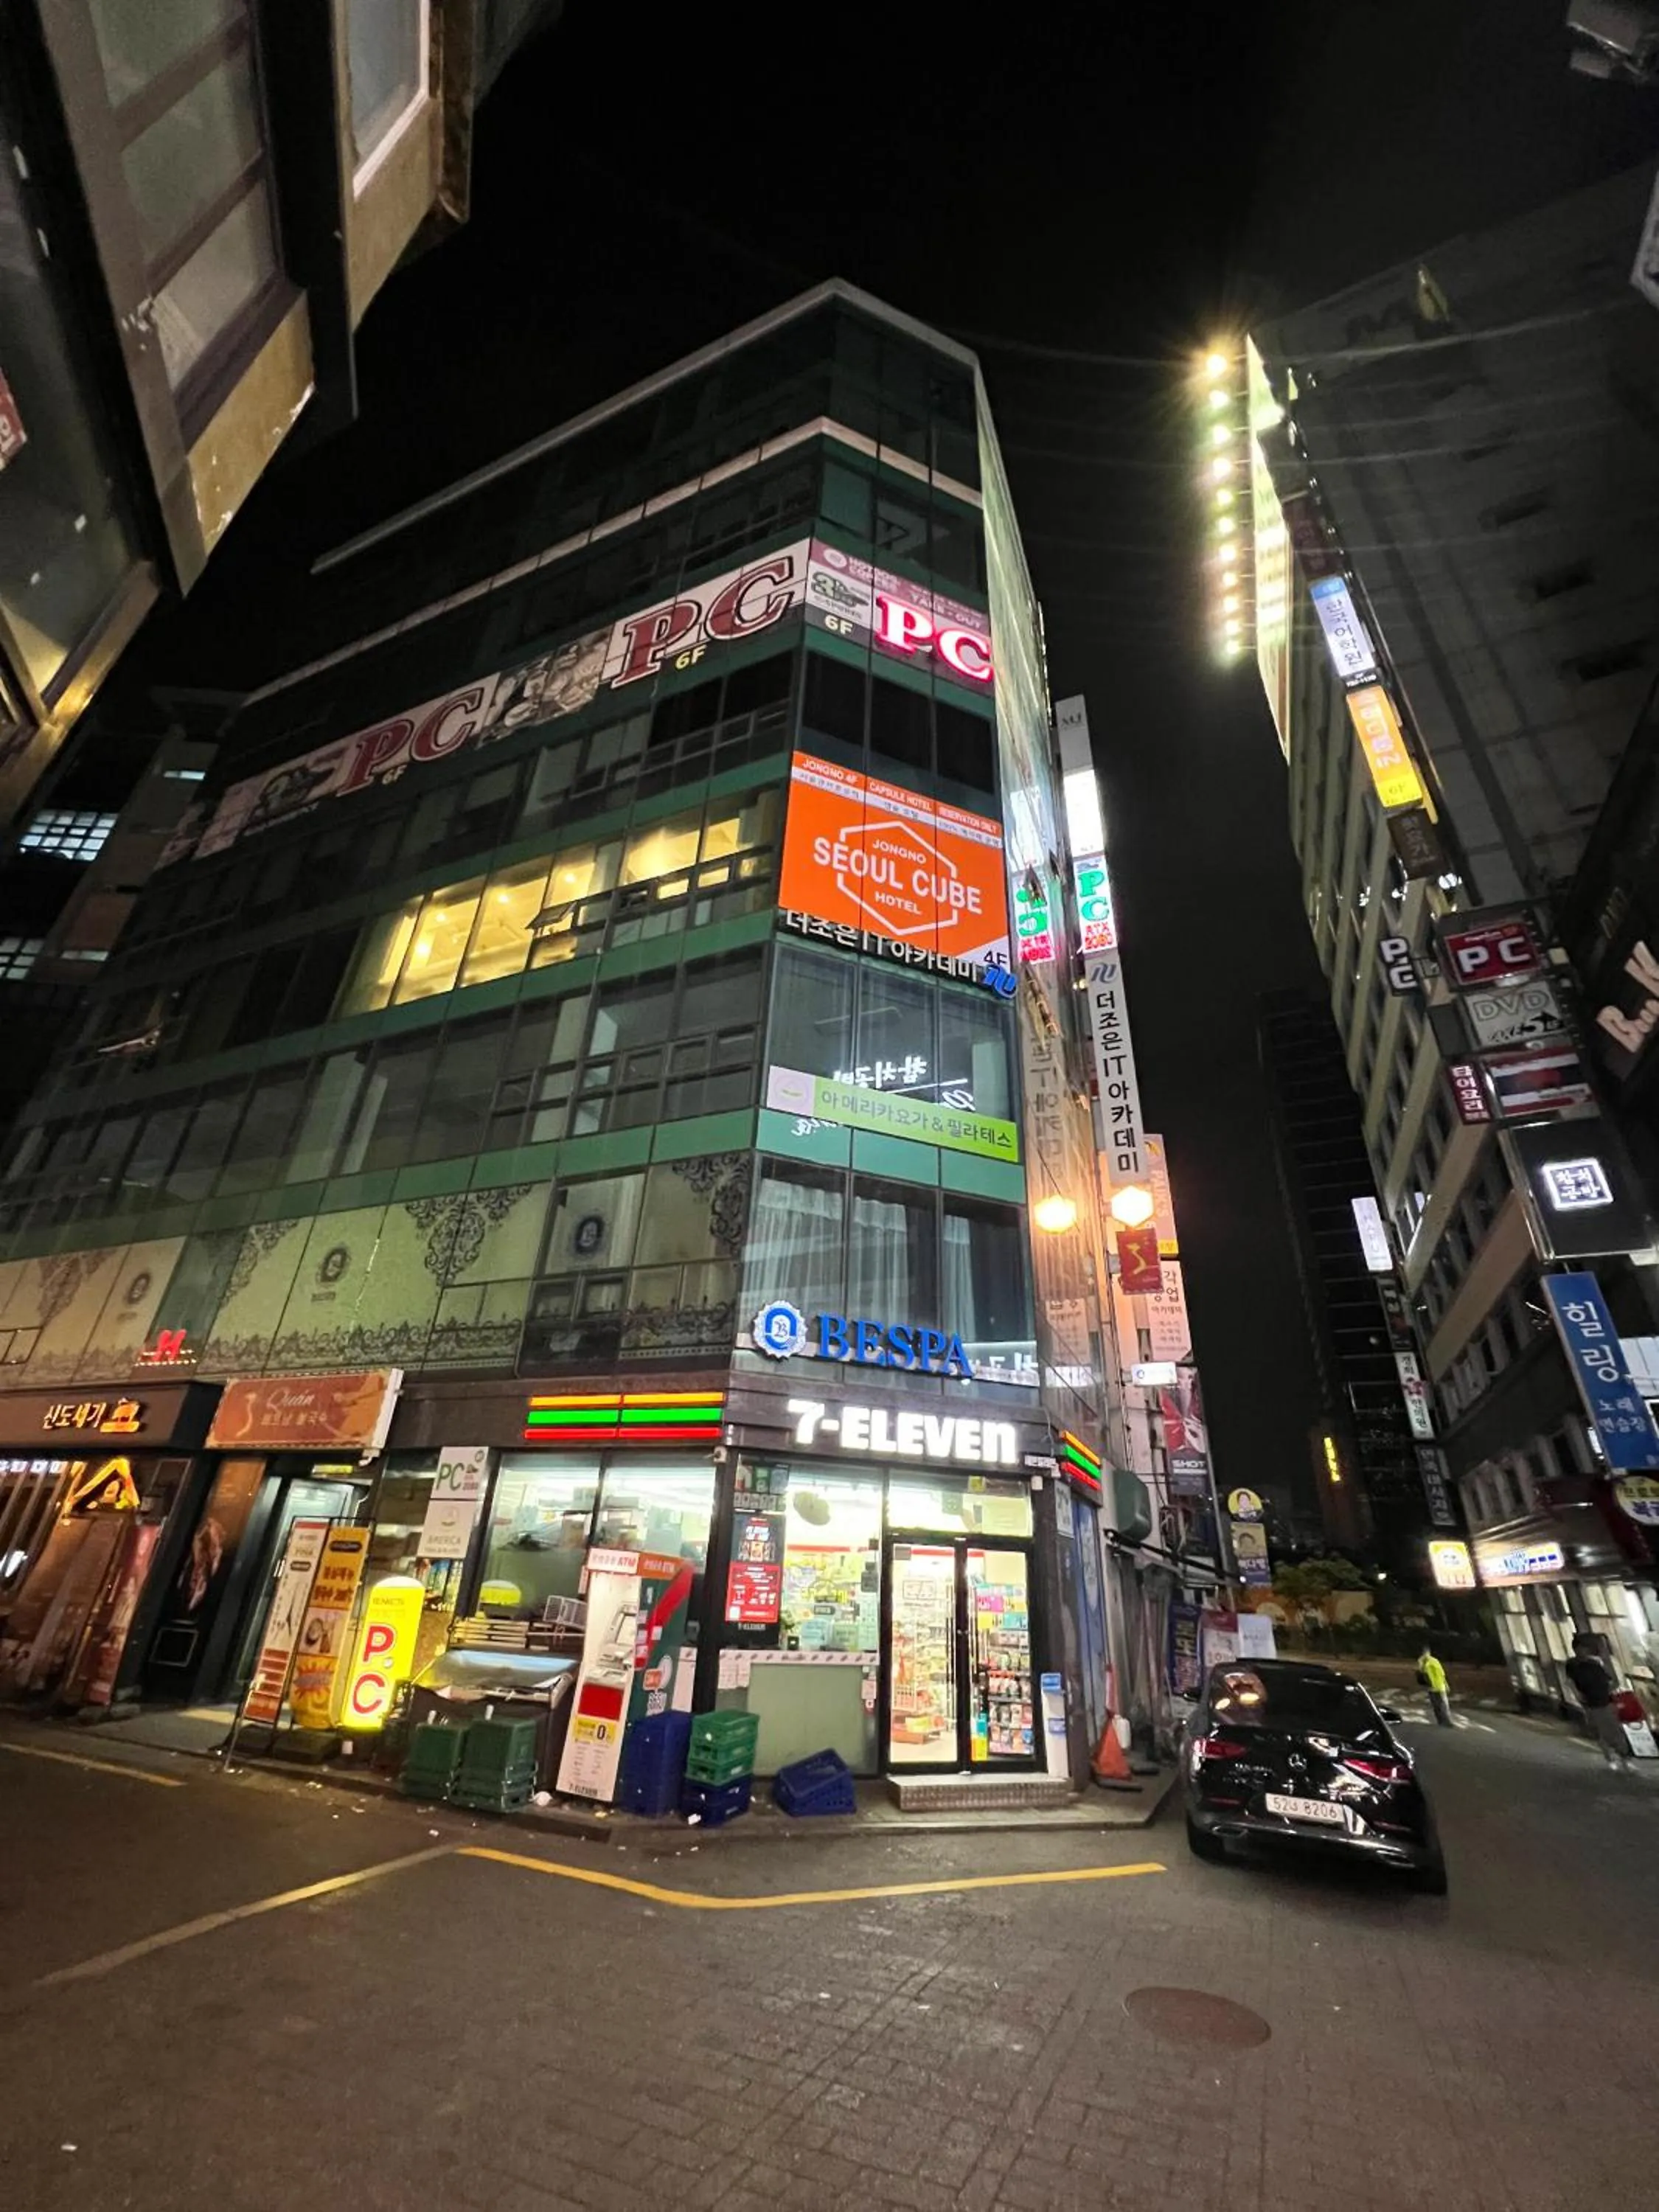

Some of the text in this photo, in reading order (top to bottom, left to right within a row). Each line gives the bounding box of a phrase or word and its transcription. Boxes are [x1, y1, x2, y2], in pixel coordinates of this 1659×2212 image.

[611, 555, 794, 690] PC
[824, 615, 853, 635] 6F
[874, 591, 994, 683] PC
[675, 646, 708, 671] 6F
[338, 686, 483, 796] PC
[382, 765, 406, 785] 6F
[803, 758, 844, 780] JONGNO
[869, 782, 905, 804] CAPSULE
[906, 797, 932, 813] HOTEL
[873, 839, 927, 863] JONGNO
[814, 838, 982, 915] SEOUL CUBE
[875, 891, 922, 915] HOTEL
[1078, 870, 1110, 921] PC
[1457, 936, 1531, 973] PC
[1472, 990, 1549, 1022] DVD
[816, 1312, 975, 1378] BESPA
[1561, 1301, 1620, 1383] 힐링
[43, 1402, 107, 1430] 신도세기
[1599, 1397, 1635, 1413] 노래
[1599, 1416, 1647, 1433] 연습장
[435, 1462, 465, 1492] PC
[427, 1534, 462, 1545] AMERICA
[353, 1625, 394, 1714] PC
